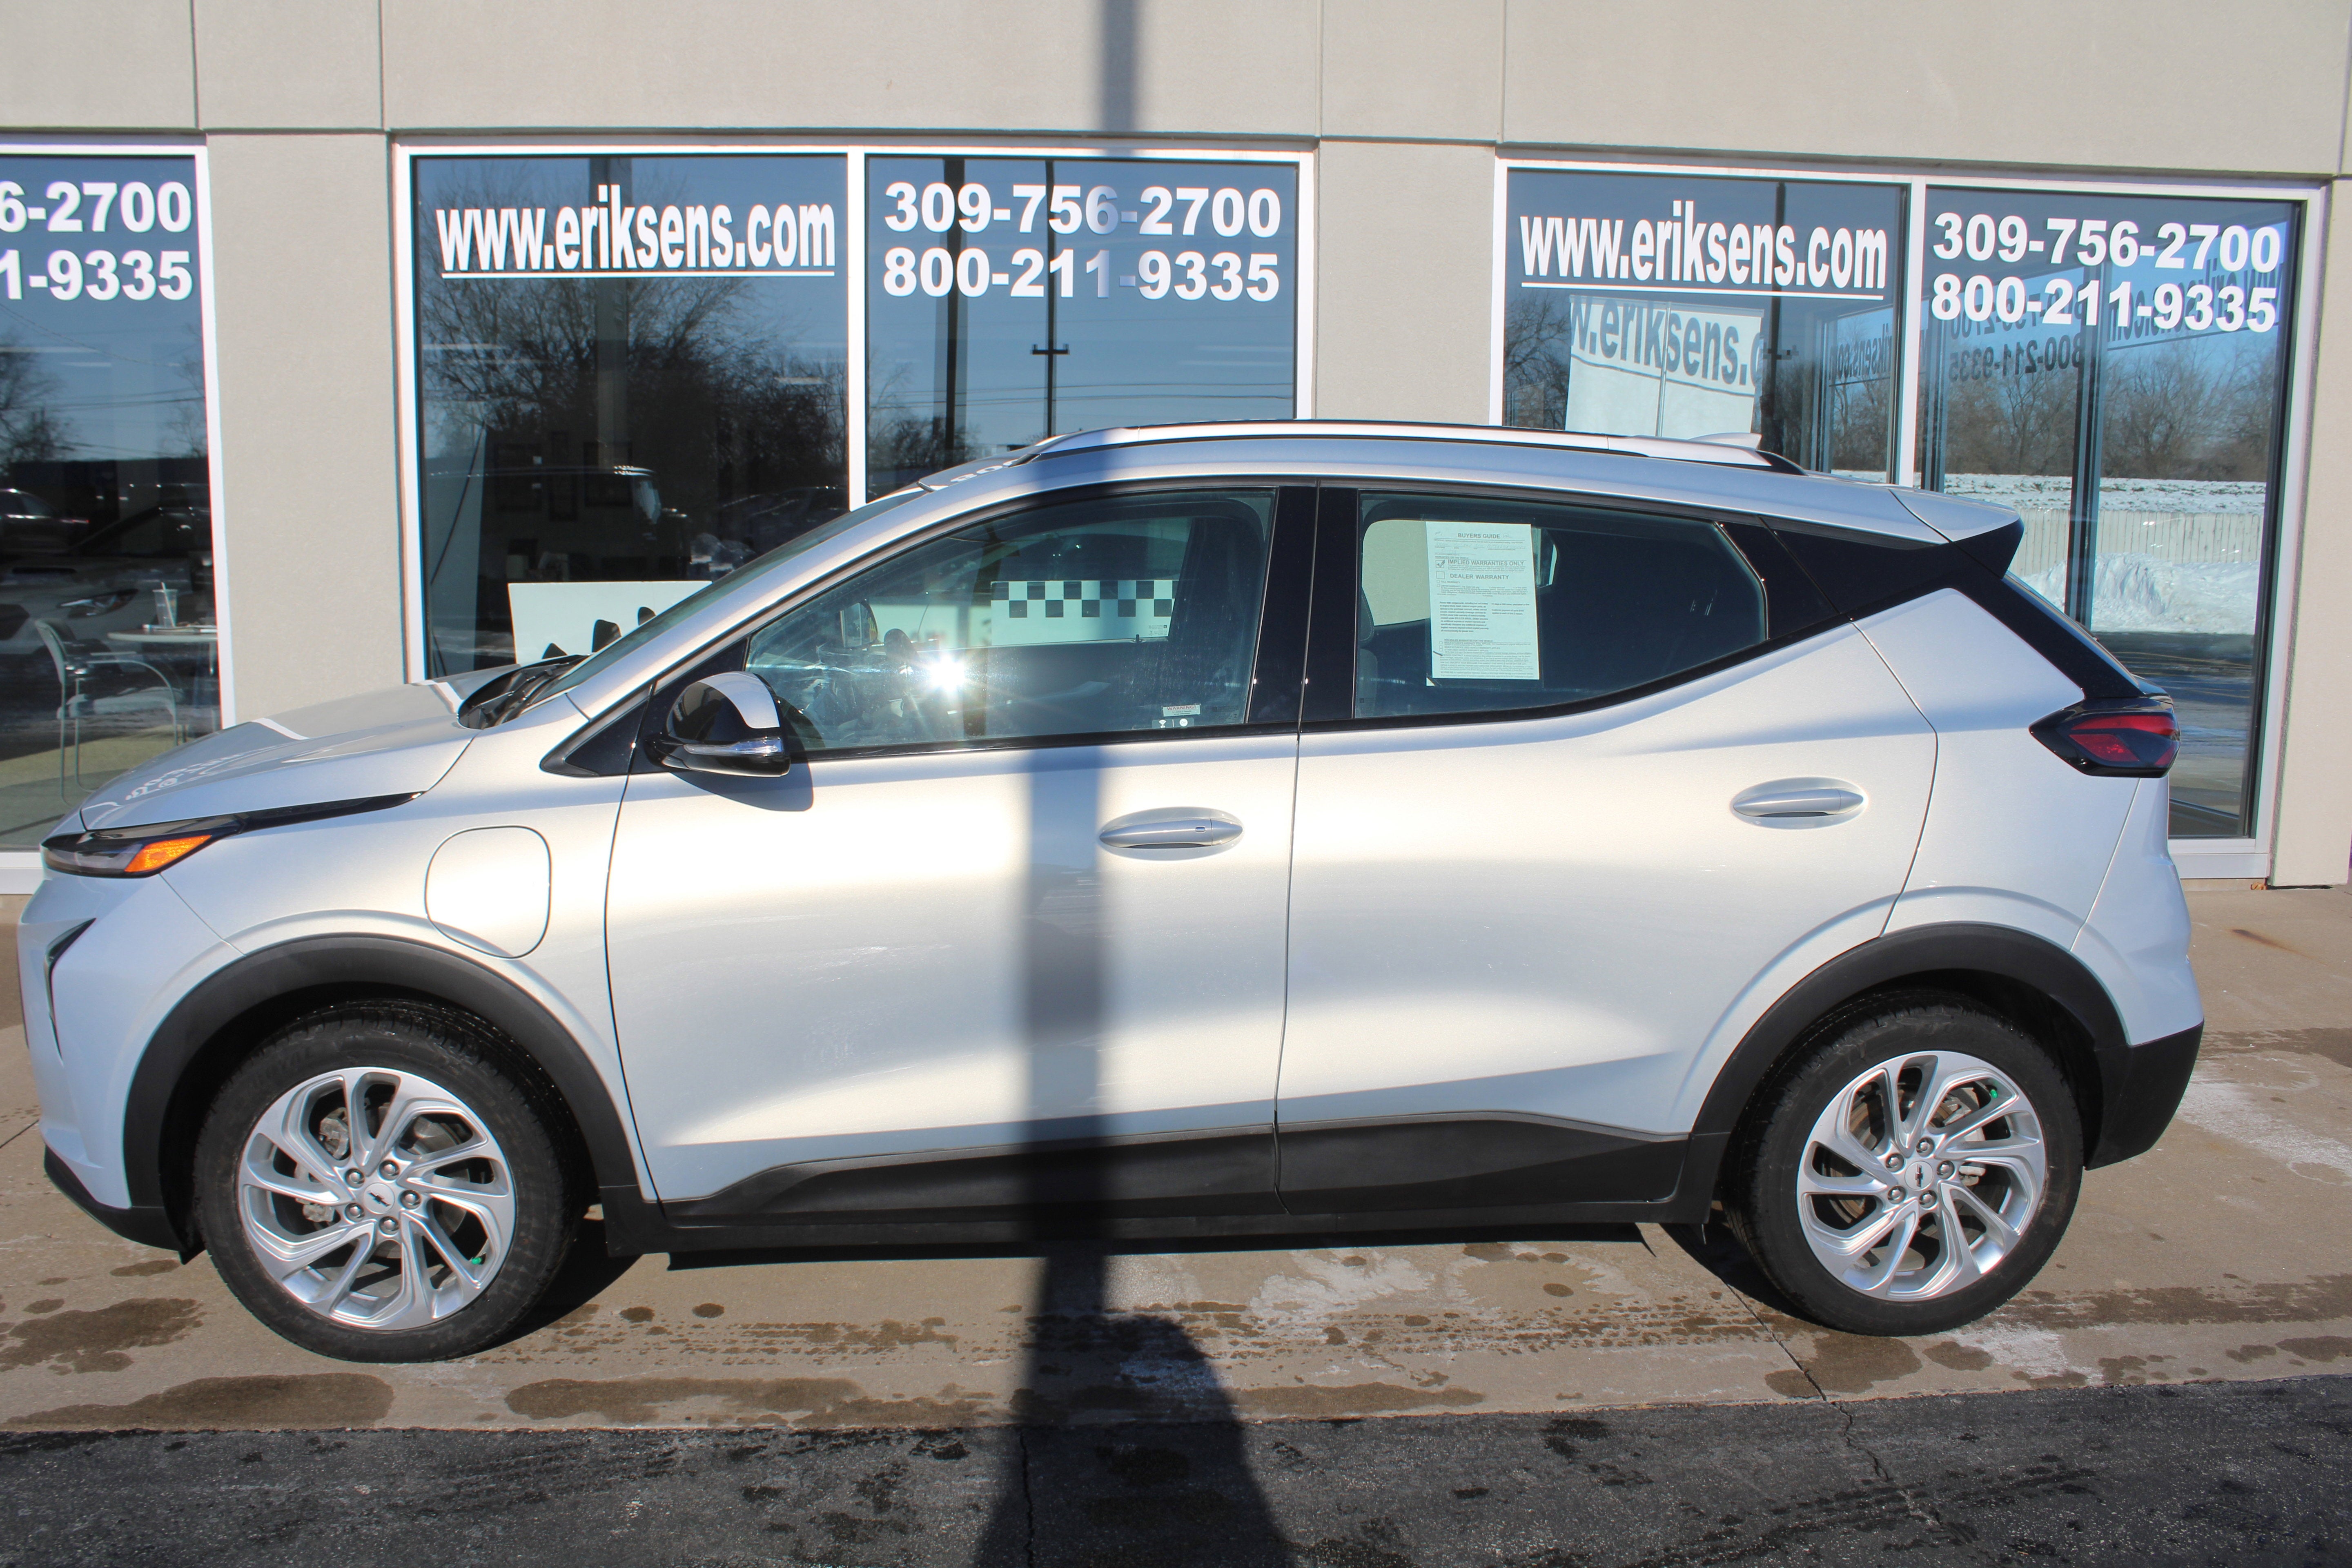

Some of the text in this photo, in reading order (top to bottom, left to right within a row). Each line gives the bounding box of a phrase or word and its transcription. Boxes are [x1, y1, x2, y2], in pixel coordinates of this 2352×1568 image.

[0, 180, 191, 232] 6-2700
[436, 184, 835, 271] www.eriksens.com
[884, 182, 1281, 238] 309-756-2700
[1519, 200, 1887, 289] www.eriksens.com
[1933, 212, 2281, 273] 309-756-2700
[0, 249, 192, 301] 1-9335
[883, 247, 1280, 302] 800-211-9335
[1931, 273, 2277, 333] 800-211-9335
